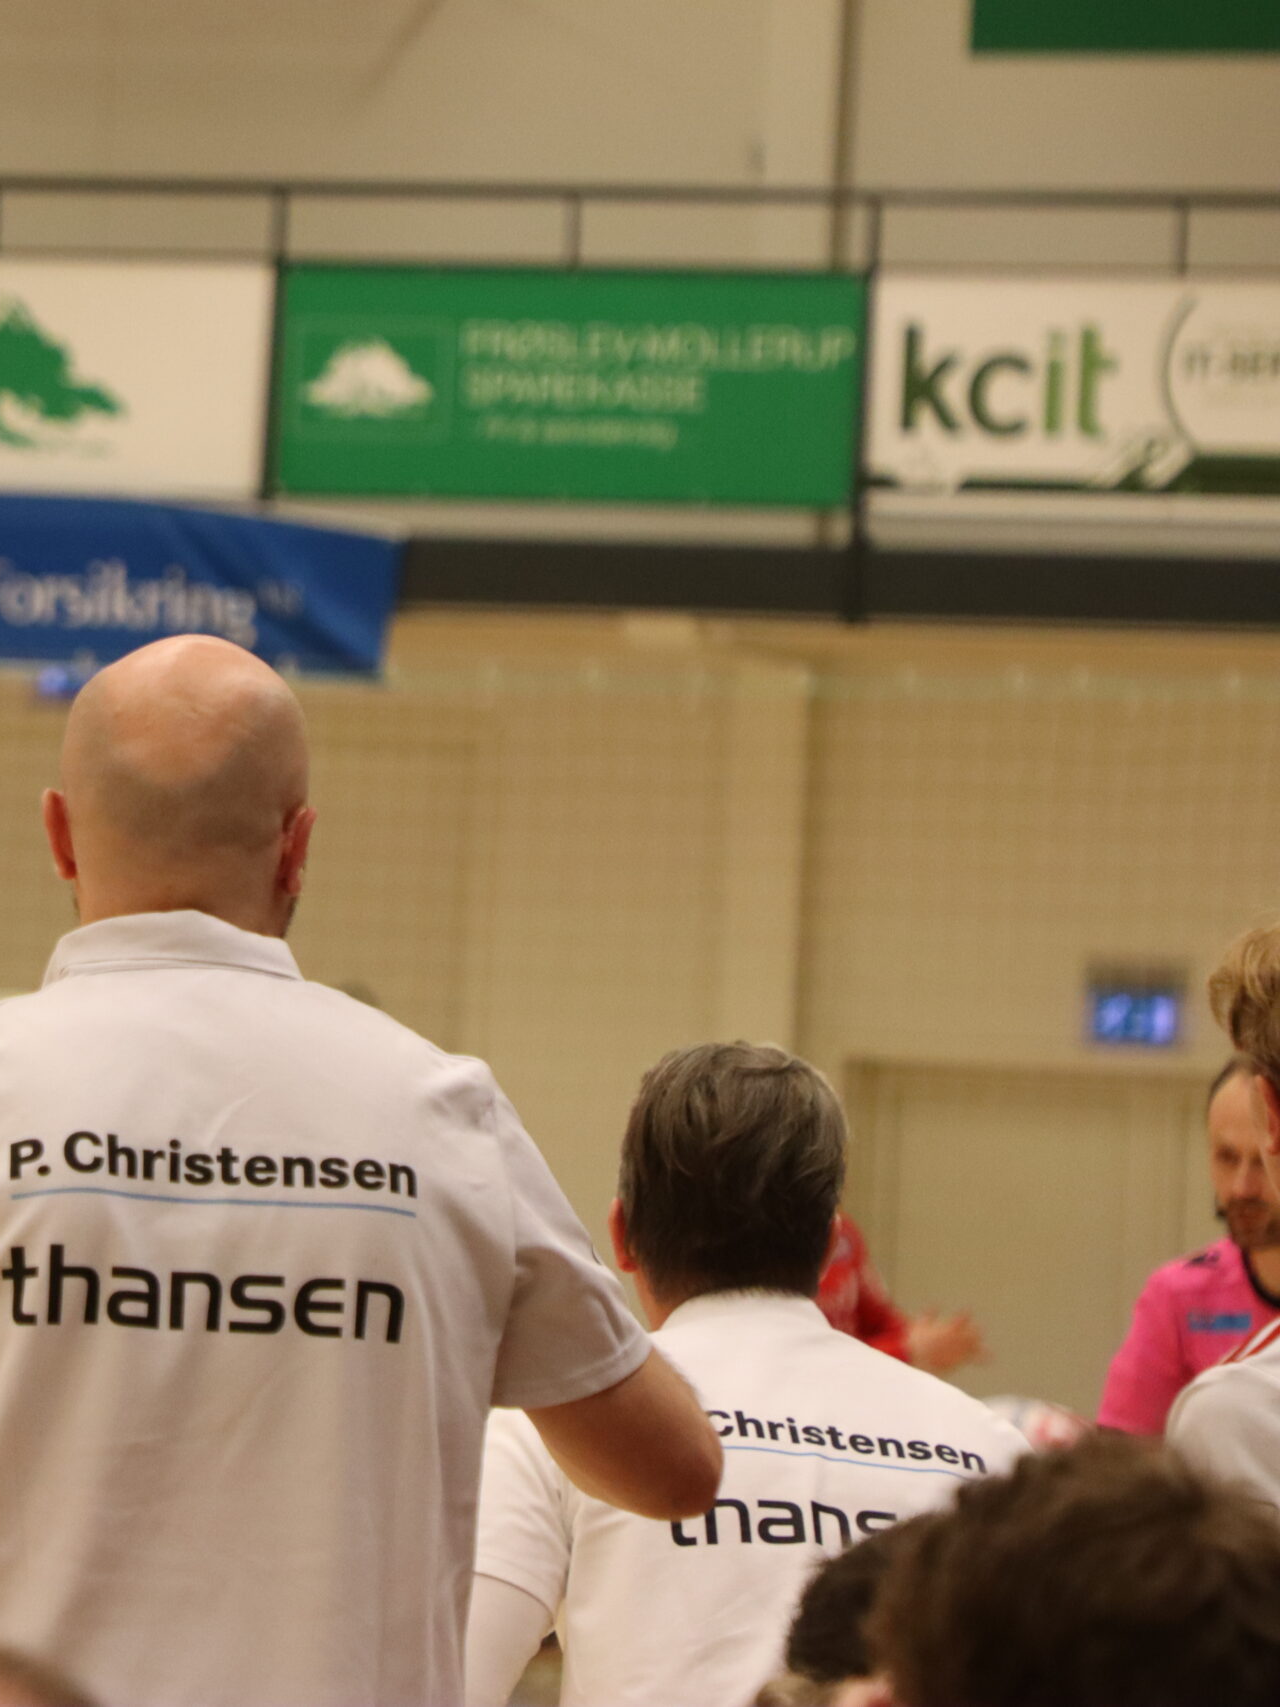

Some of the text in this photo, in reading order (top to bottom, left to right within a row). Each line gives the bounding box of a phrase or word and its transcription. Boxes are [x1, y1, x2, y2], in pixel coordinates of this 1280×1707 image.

[10, 1130, 418, 1198] P. Christensen
[2, 1244, 405, 1344] thansen
[706, 1410, 988, 1474] Christensen
